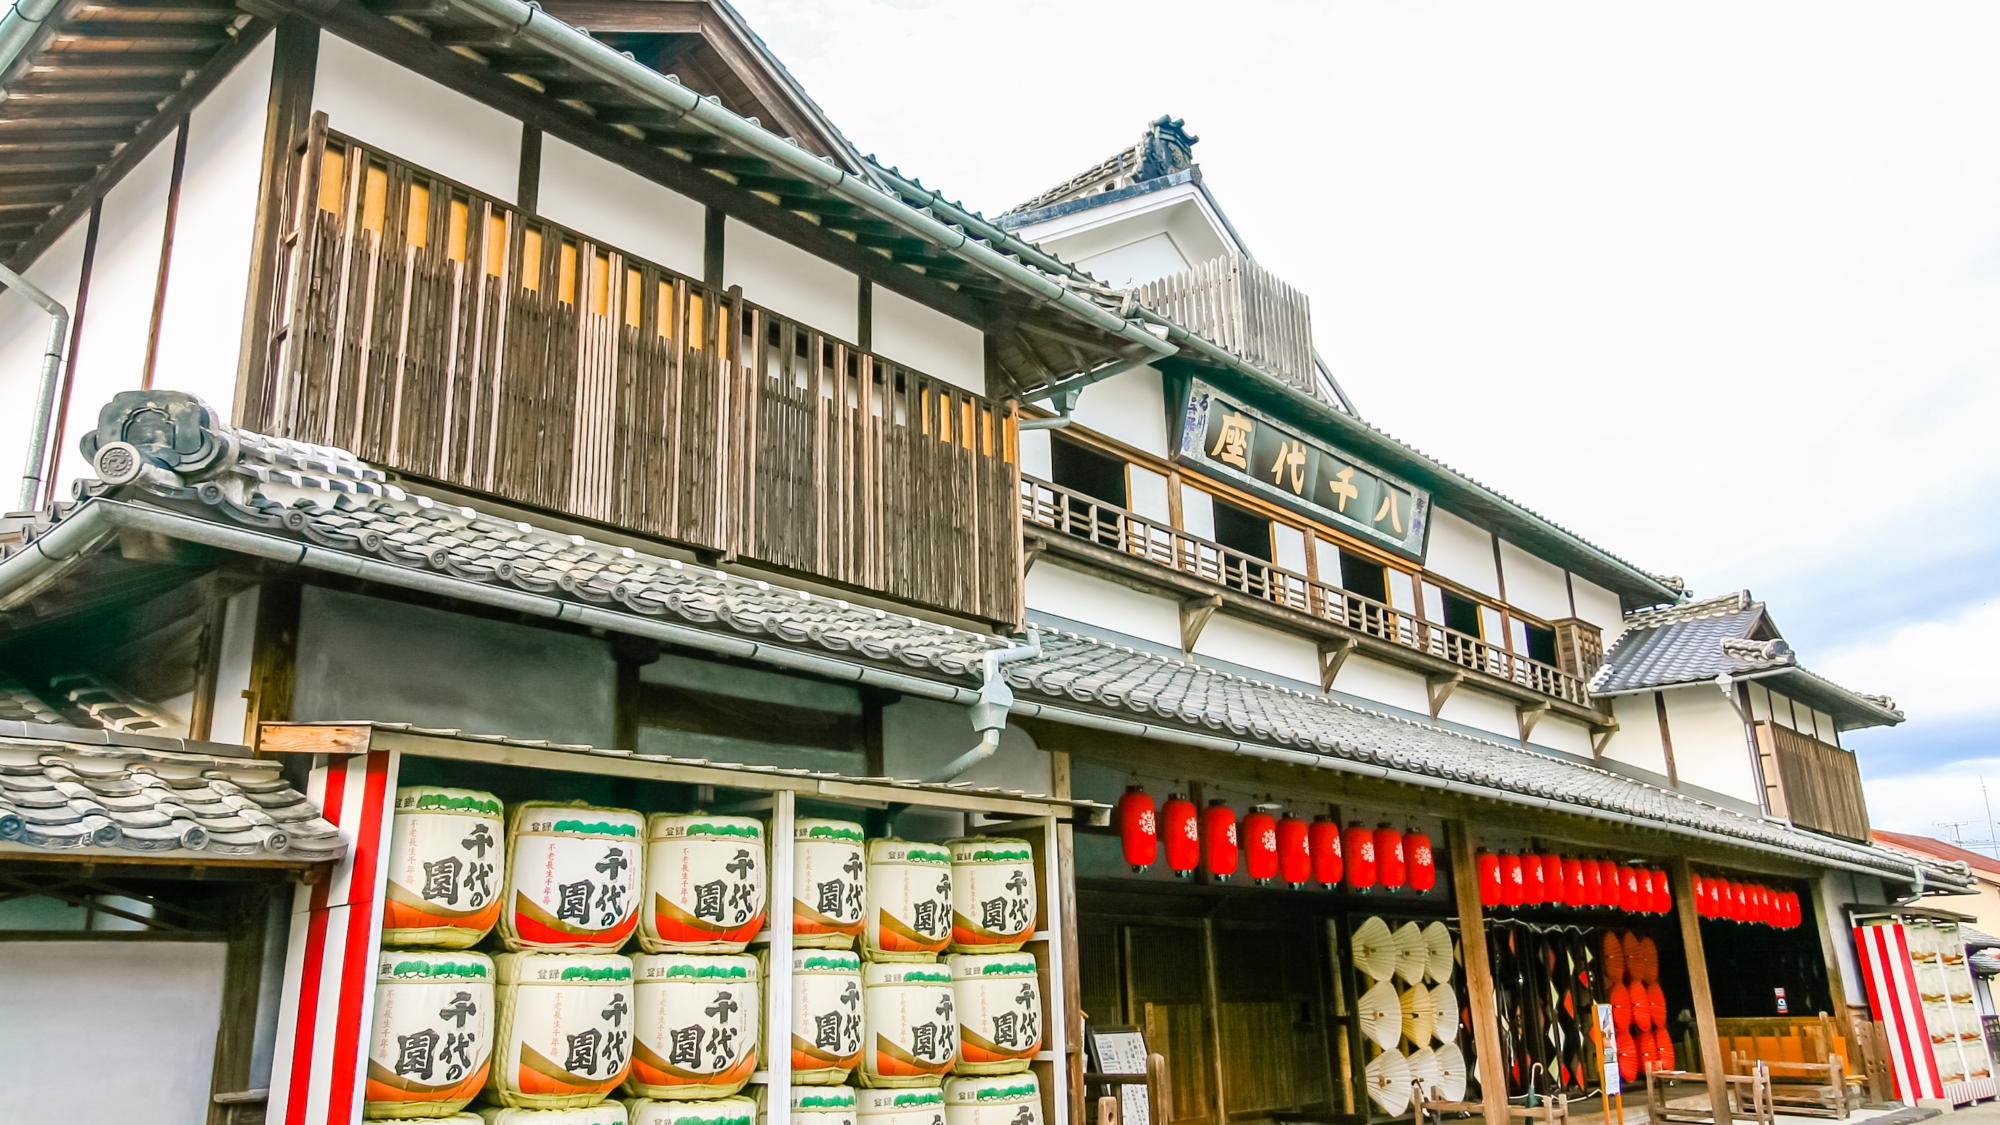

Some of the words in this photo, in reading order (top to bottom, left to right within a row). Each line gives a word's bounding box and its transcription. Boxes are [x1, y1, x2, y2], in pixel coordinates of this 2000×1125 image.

[461, 824, 494, 907] 千代の
[595, 847, 628, 926] 千代の
[726, 849, 755, 923] 千代の
[439, 991, 477, 1081] 千代の
[601, 993, 628, 1075] 千代の
[705, 991, 738, 1069] 千代の
